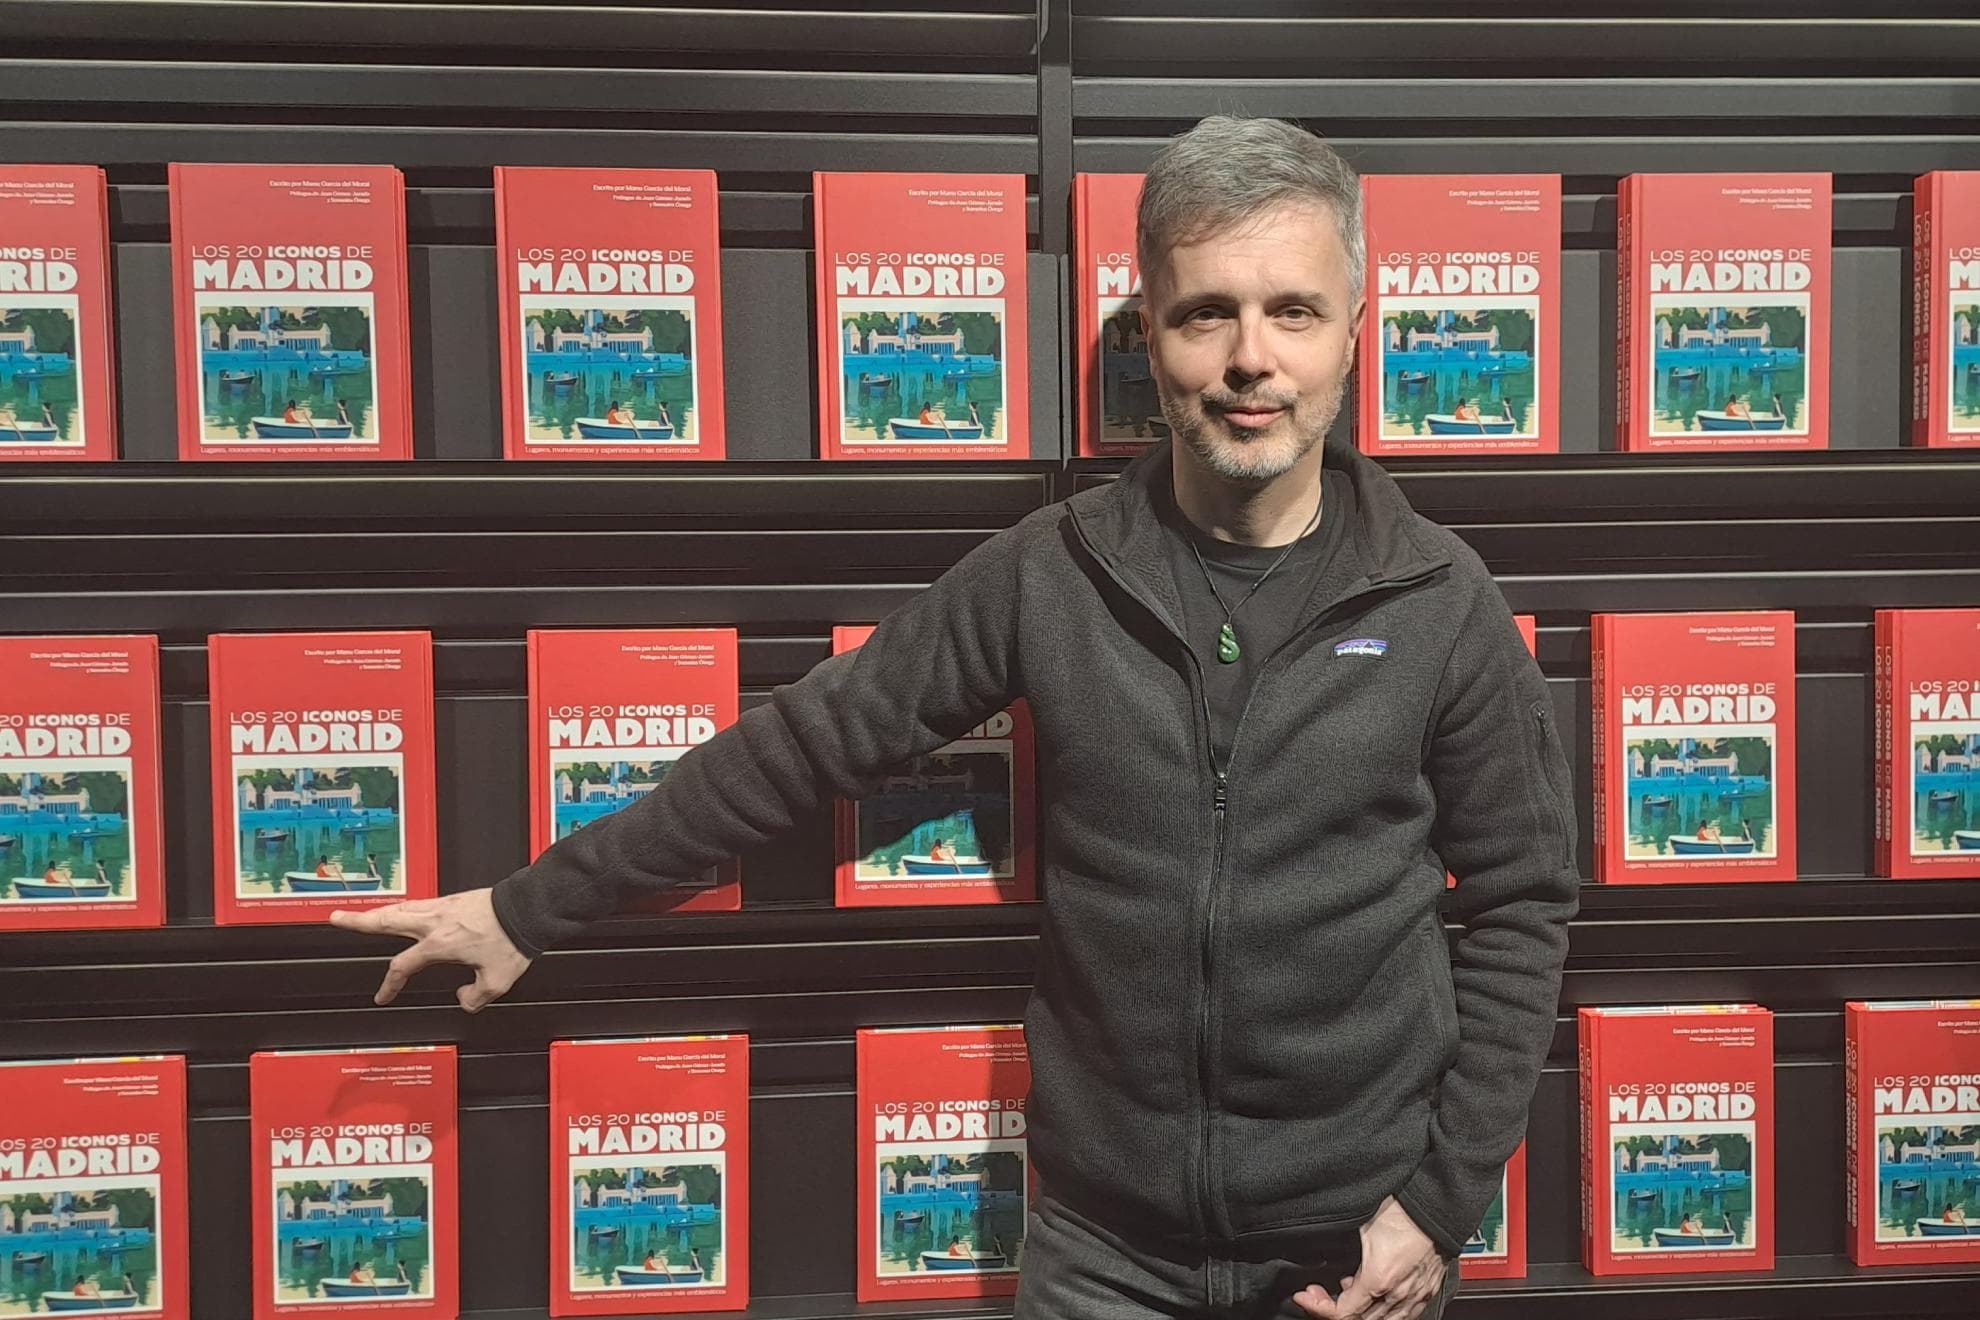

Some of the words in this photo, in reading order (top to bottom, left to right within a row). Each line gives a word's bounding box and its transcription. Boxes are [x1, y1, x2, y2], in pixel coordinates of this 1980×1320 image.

[51, 248, 77, 260] DE
[193, 245, 230, 258] LOS
[236, 246, 262, 258] 20
[269, 246, 341, 258] ICONOS
[347, 246, 372, 258] DE
[518, 248, 554, 261] LOS
[560, 249, 586, 261] 20
[592, 250, 663, 262] ICONOS
[669, 250, 694, 262] DE
[836, 252, 871, 265] LOS
[877, 253, 901, 265] 20
[907, 253, 975, 265] ICONOS
[981, 254, 1005, 265] DE
[1097, 253, 1131, 265] LOS
[1378, 252, 1412, 265] LOS
[1417, 252, 1441, 265] 20
[1446, 252, 1511, 264] ICONOS
[1517, 252, 1540, 263] DE
[1651, 250, 1684, 263] LOS
[1690, 250, 1713, 262] 20
[1718, 248, 1784, 262] ICONOS
[1789, 248, 1812, 260] DE
[193, 260, 373, 289] MADRID
[518, 263, 694, 292] MADRID
[836, 267, 1005, 295] MADRID
[1378, 265, 1539, 294] MADRID
[1651, 262, 1811, 291] MADRID
[1623, 685, 1654, 697] LOS
[1659, 685, 1682, 696] 20
[1687, 683, 1748, 696] ICONOS
[1754, 683, 1776, 694] DE
[1911, 681, 1942, 693] LOS
[1947, 681, 1969, 692] 20
[231, 711, 267, 724] LOS
[272, 711, 297, 723] 20
[303, 710, 372, 723] ICONOS
[378, 709, 402, 721] DE
[549, 706, 584, 718] LOS
[589, 706, 613, 718] 20
[619, 704, 686, 717] ICONOS
[692, 704, 716, 716] DE
[1623, 696, 1776, 724] MADRID
[0, 715, 23, 727] 20
[30, 714, 100, 727] ICONOS
[106, 713, 131, 725] DE
[231, 723, 402, 753] MADRID
[549, 717, 716, 747] MADRID
[1609, 1084, 1640, 1096] LOS
[1645, 1084, 1666, 1095] 20
[1671, 1082, 1730, 1094] ICONOS
[1735, 1082, 1755, 1092] DE
[1875, 1076, 1905, 1088] LOS
[1909, 1076, 1930, 1087] 20
[876, 1102, 907, 1115] LOS
[912, 1101, 934, 1113] 20
[940, 1099, 1001, 1112] ICONOS
[1006, 1098, 1027, 1110] DE
[1609, 1094, 1755, 1122] MADRID
[569, 1114, 602, 1127] LOS
[607, 1114, 630, 1126] 20
[635, 1111, 698, 1125] ICONOS
[704, 1111, 726, 1122] DE
[876, 1111, 1027, 1141] MADRID
[271, 1126, 305, 1139] LOS
[310, 1126, 334, 1138] 20
[339, 1123, 404, 1137] ICONOS
[410, 1123, 432, 1134] DE
[569, 1123, 726, 1154] MADRID
[0, 1138, 25, 1151] OS
[31, 1137, 56, 1149] 20
[62, 1134, 130, 1148] ICONOS
[136, 1133, 160, 1145] DE
[271, 1136, 432, 1166] MADRID
[0, 1146, 160, 1179] MADRID
